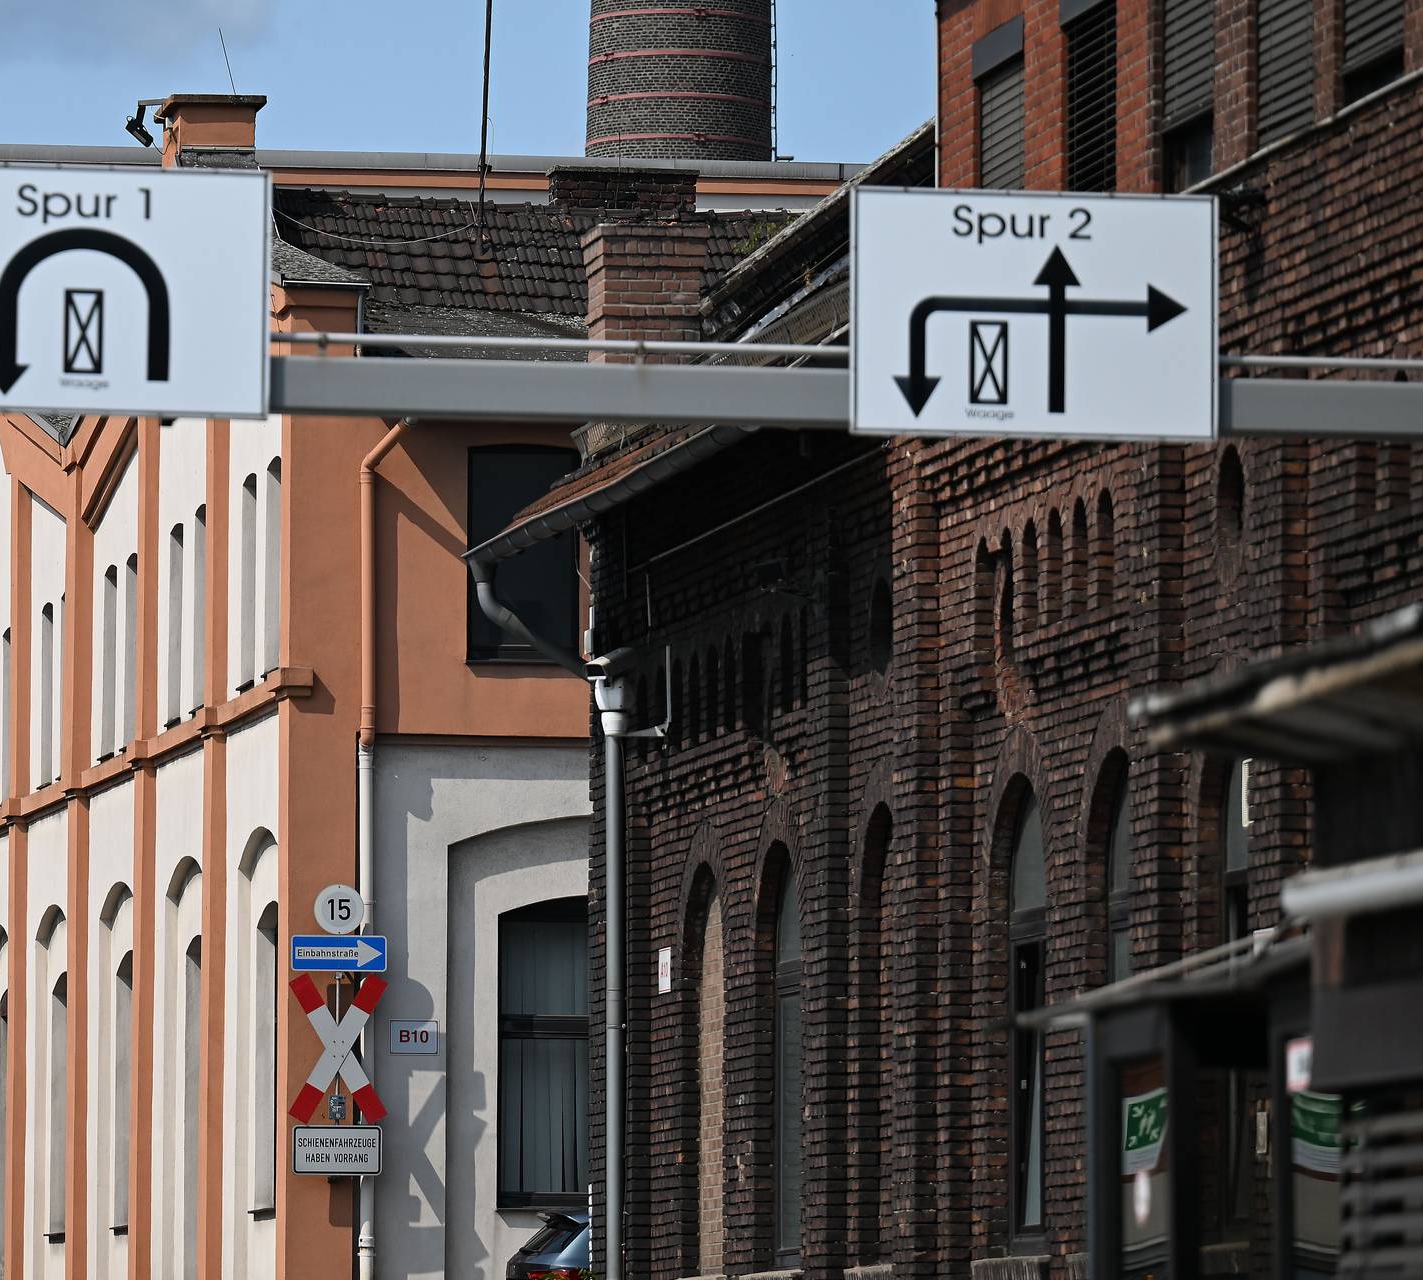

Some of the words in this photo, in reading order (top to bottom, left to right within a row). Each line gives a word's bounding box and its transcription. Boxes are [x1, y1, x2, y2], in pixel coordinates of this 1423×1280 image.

[16, 183, 117, 224] Spur
[138, 188, 153, 220] 1
[952, 204, 1050, 244] Spur
[1068, 207, 1092, 240] 2
[965, 408, 1015, 421] Waage
[327, 899, 351, 921] 15
[297, 948, 359, 958] Einbahnstraße
[399, 1029, 429, 1043] B10
[298, 1137, 376, 1148] SCHIENENFAHRZEUGE
[305, 1153, 331, 1163] HABEN
[334, 1153, 369, 1163] VORRANG
